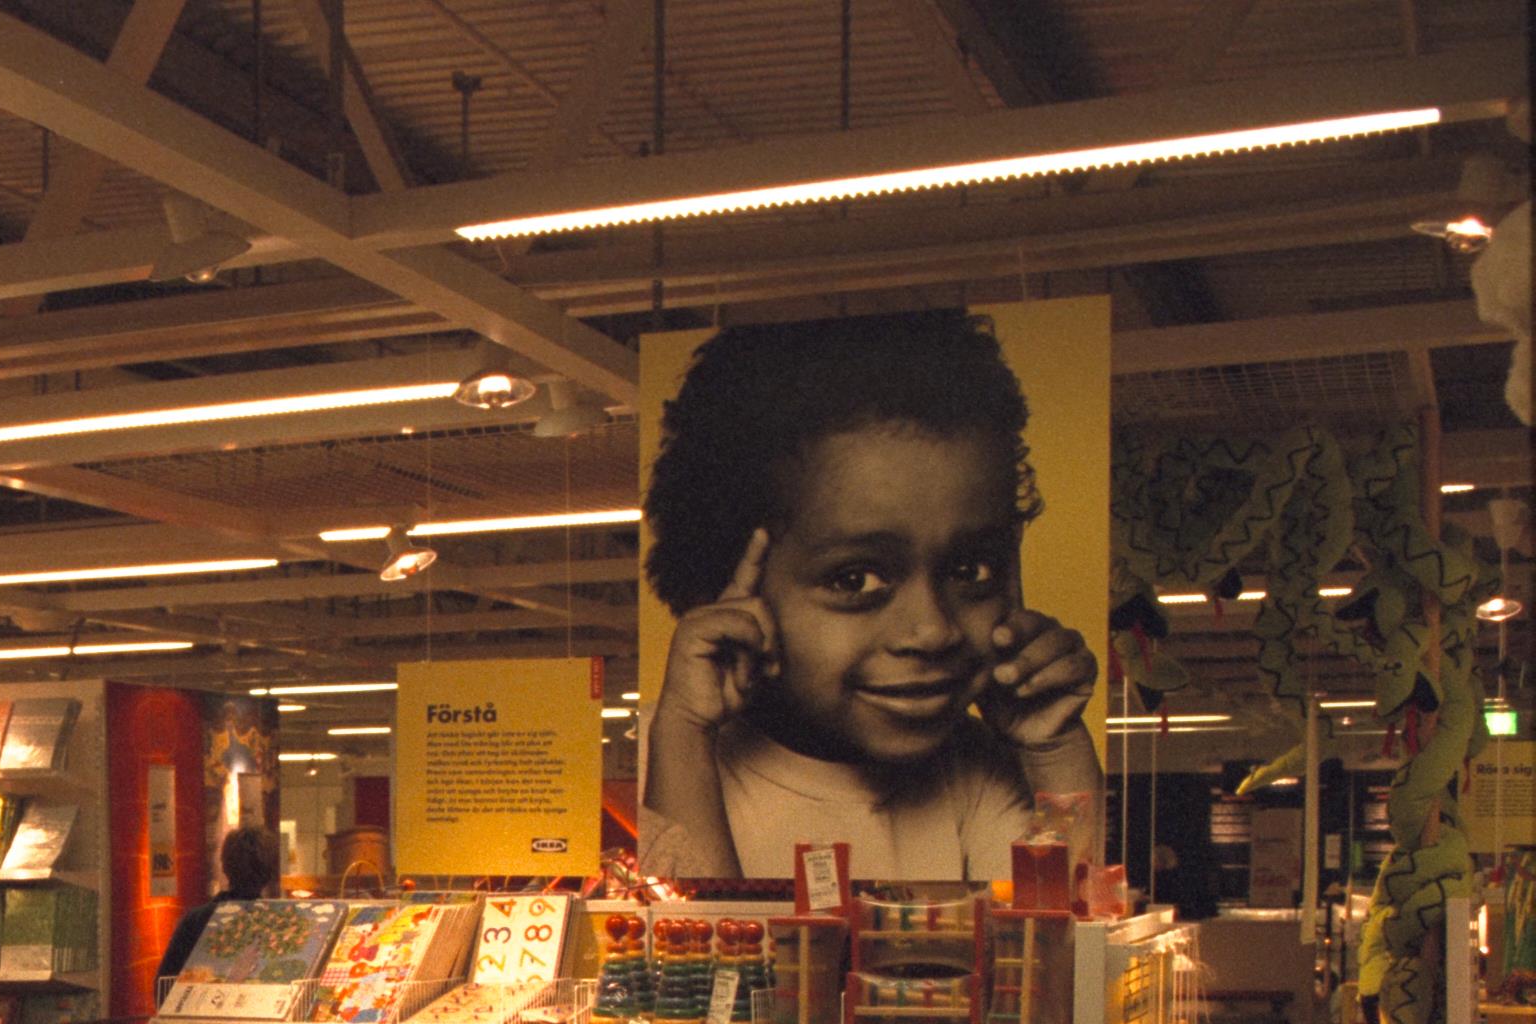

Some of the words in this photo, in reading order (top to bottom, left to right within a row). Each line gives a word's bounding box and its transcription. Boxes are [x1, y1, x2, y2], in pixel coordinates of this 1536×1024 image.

[427, 702, 497, 723] Förstå
[1513, 762, 1533, 777] sig
[533, 840, 566, 851] IKEA
[490, 899, 517, 918] 4
[529, 898, 556, 917] 9
[484, 927, 511, 944] 3
[525, 924, 552, 942] 8
[477, 954, 506, 973] 2
[520, 948, 547, 967] 7
